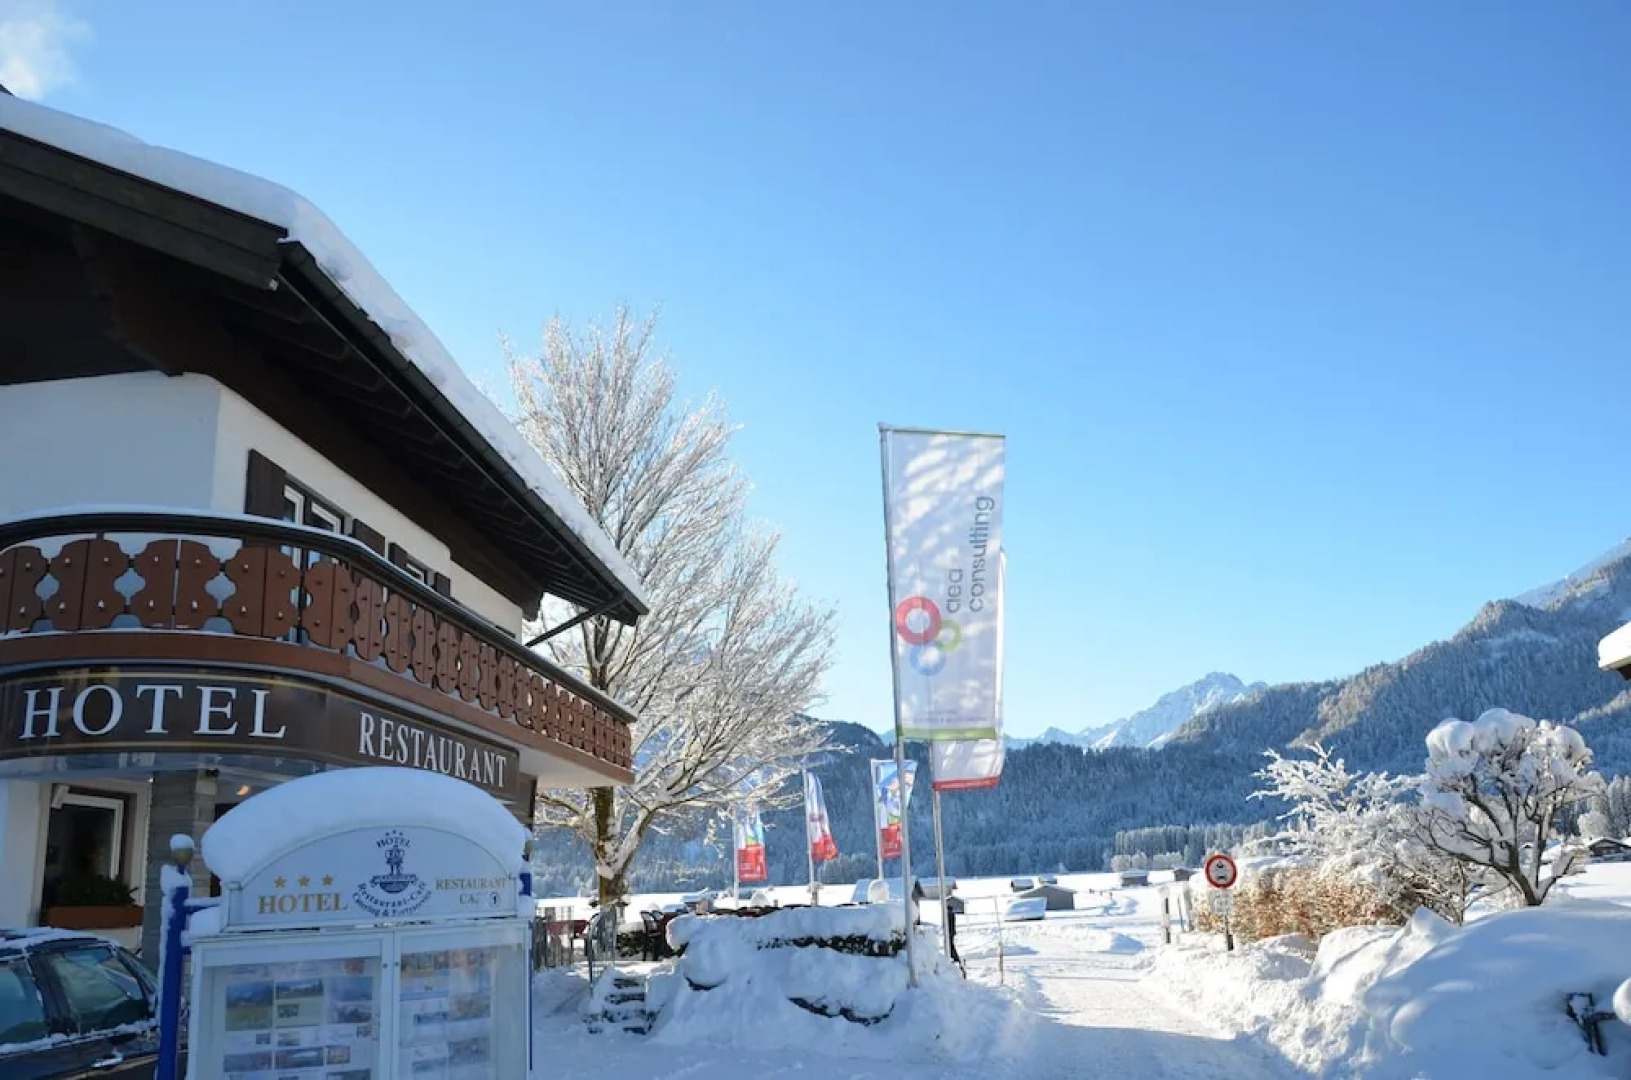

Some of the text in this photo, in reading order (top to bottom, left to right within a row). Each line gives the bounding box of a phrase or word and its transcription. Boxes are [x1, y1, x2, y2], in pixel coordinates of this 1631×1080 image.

[969, 496, 995, 613] consulting
[18, 684, 287, 740] HOTEL
[358, 710, 507, 789] RESTAURANT
[376, 836, 411, 848] HOTEL
[258, 892, 349, 915] HOTEL
[434, 877, 507, 891] RESTAURANT
